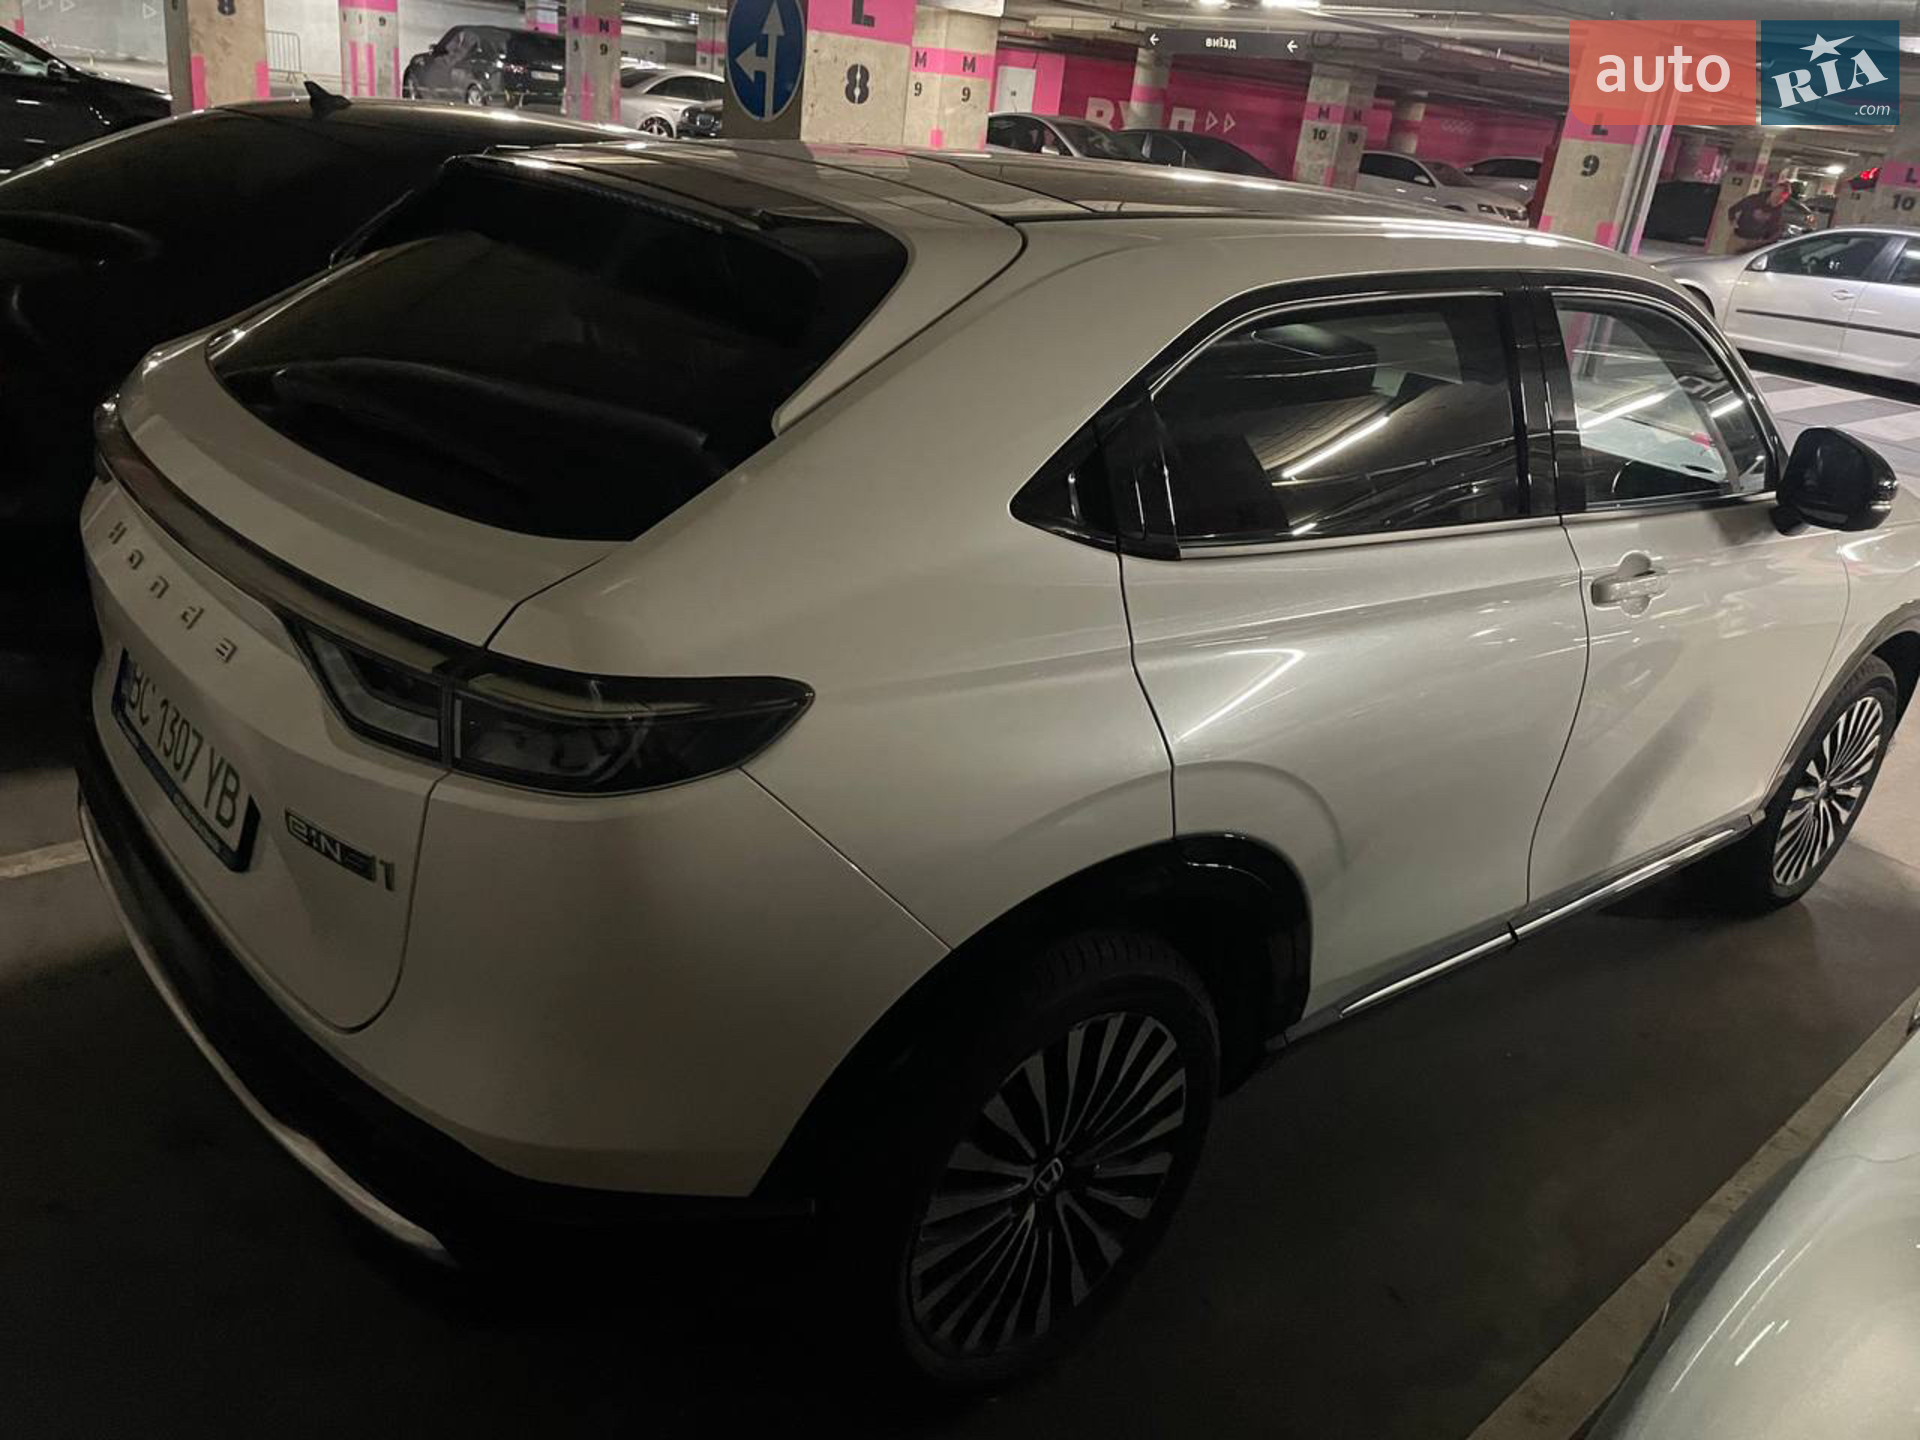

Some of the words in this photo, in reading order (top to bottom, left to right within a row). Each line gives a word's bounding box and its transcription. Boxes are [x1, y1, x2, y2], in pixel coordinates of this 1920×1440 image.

[852, 0, 875, 27] L
[1205, 36, 1237, 50] виїзд
[914, 51, 927, 68] M
[962, 56, 976, 73] M
[845, 64, 870, 104] 8
[914, 82, 922, 97] 9
[961, 87, 971, 102] 9
[1312, 128, 1327, 141] 10
[1581, 154, 1600, 177] 9
[1893, 193, 1915, 211] 10
[157, 698, 204, 783] 1307
[203, 746, 241, 829] YB
